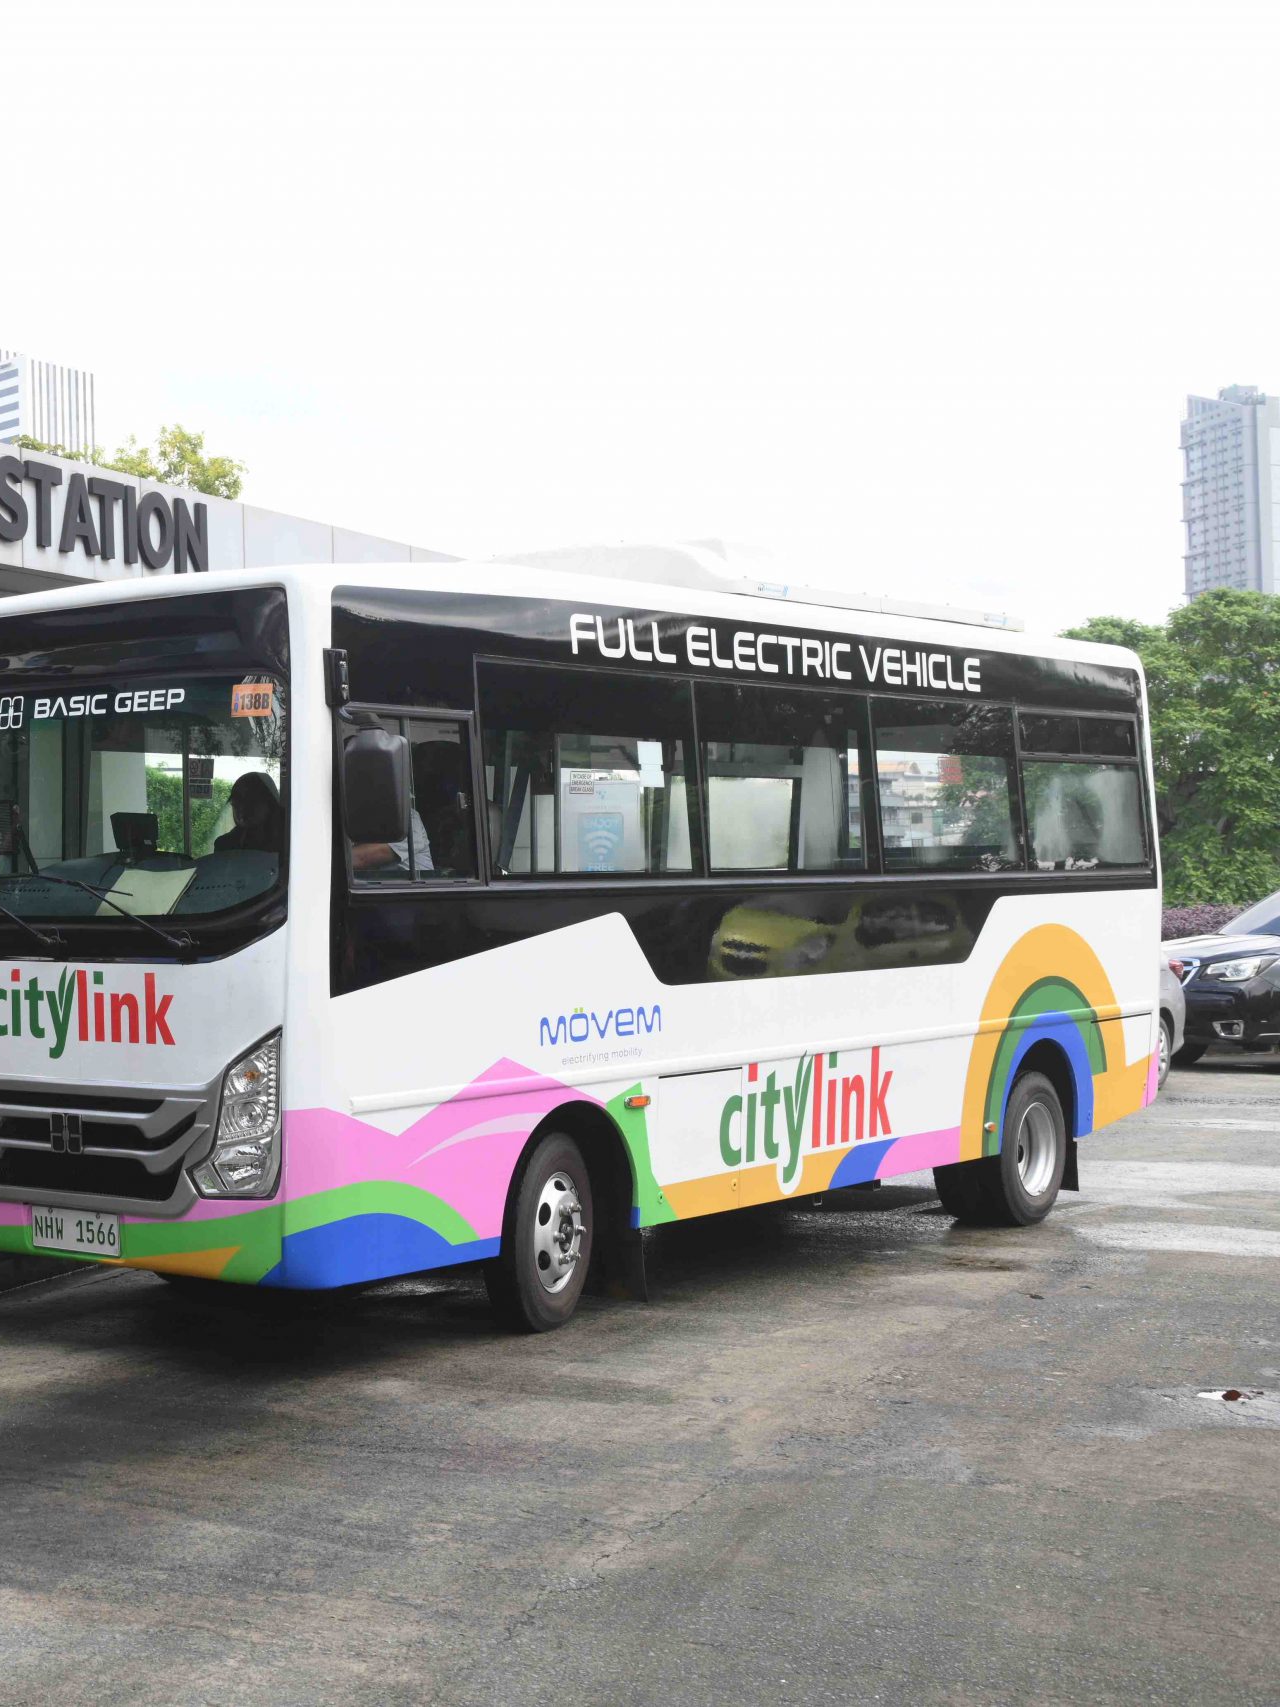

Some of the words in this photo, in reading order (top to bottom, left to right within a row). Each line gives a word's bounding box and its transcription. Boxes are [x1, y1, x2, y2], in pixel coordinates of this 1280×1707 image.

[569, 612, 677, 665] FULL
[686, 625, 852, 681] ELECTRIC
[858, 644, 981, 694] VEHICLE
[34, 693, 108, 719] BASIC
[114, 688, 185, 714] GEEP
[561, 1051, 609, 1066] electrifying
[611, 1047, 643, 1058] mobility
[720, 1045, 894, 1184] citylink
[34, 1214, 64, 1240] NHW
[75, 1219, 116, 1247] 1566
